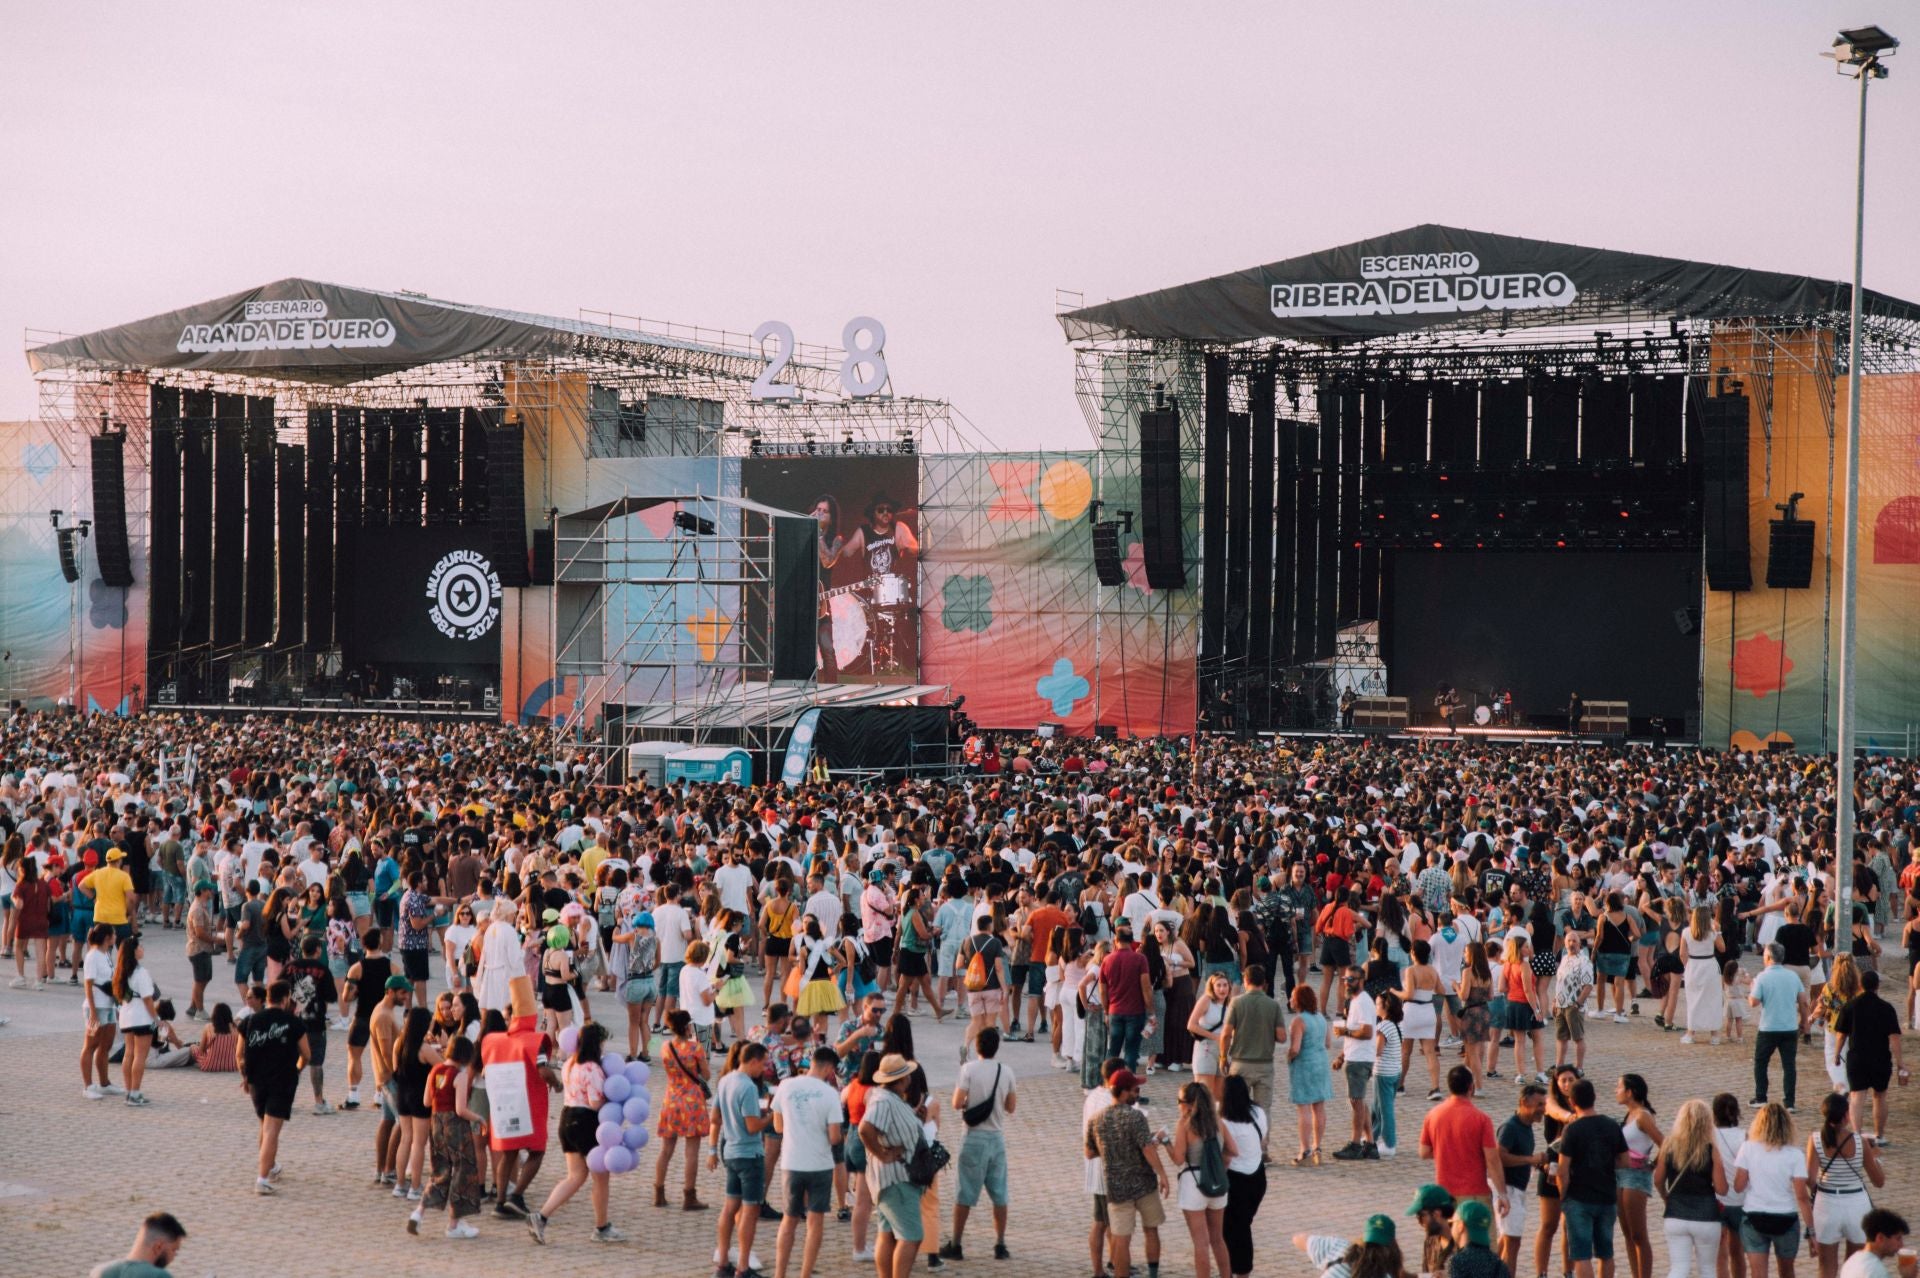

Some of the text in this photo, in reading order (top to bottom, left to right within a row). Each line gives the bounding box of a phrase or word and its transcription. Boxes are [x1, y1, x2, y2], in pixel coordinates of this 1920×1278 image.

[1361, 253, 1474, 273] ESCENARIO
[1272, 273, 1568, 308] RIBERA DEL DUERO
[246, 300, 325, 316] ESCENARIO
[179, 319, 391, 346] ARANDA DE DUERO
[426, 550, 502, 598] MUGURUZA FM
[428, 605, 456, 638] 1984
[466, 606, 499, 640] 2024
